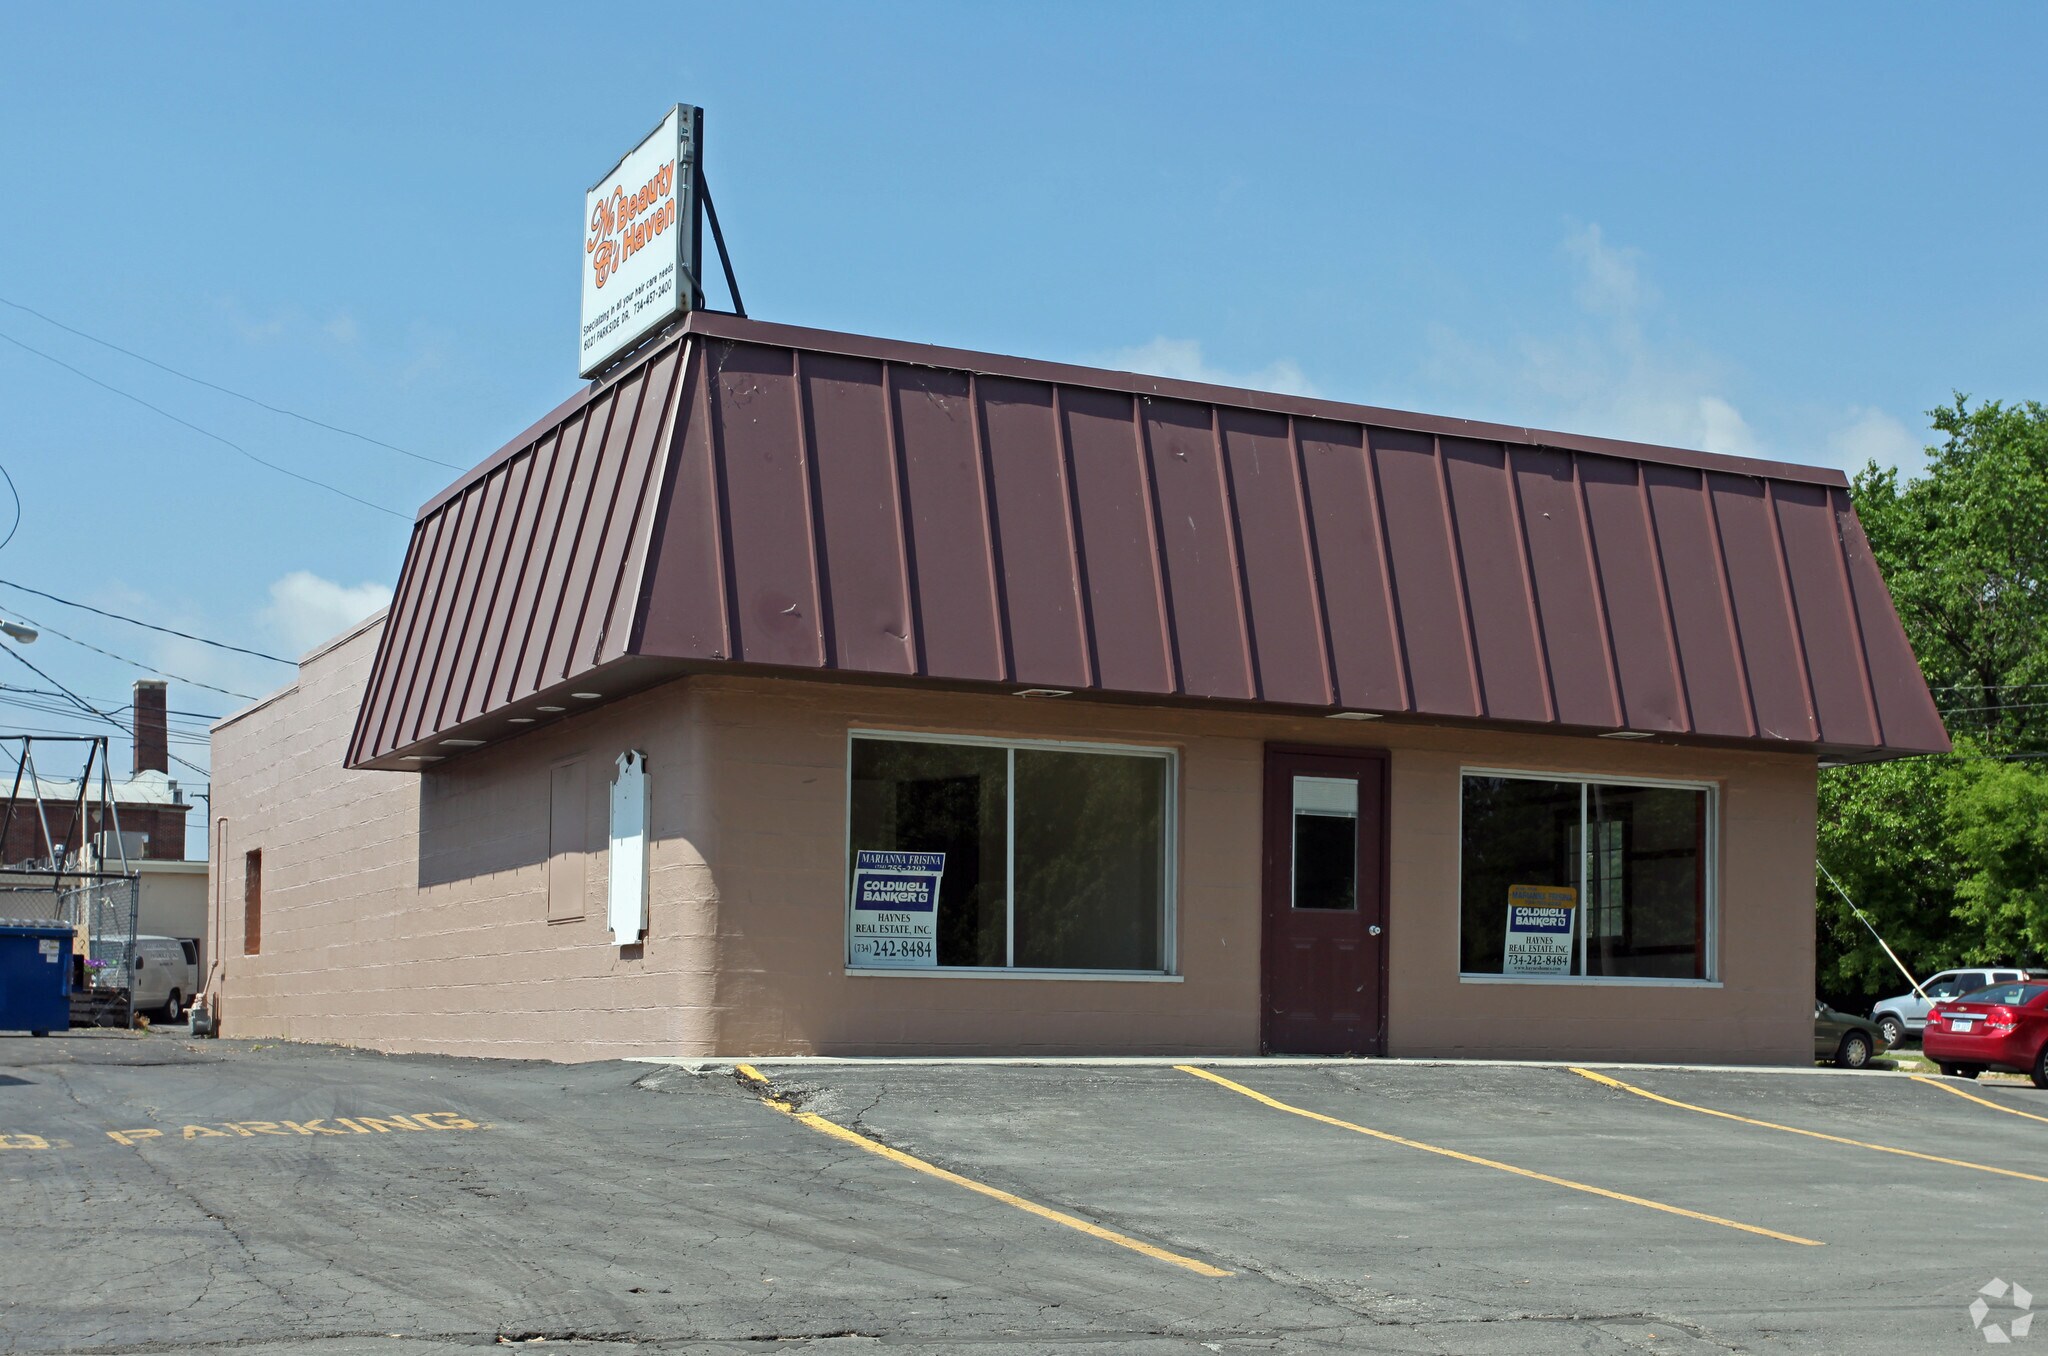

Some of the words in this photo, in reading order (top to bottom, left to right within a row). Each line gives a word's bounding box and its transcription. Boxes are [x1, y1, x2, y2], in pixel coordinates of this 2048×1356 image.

[616, 159, 674, 234] Beauty
[622, 197, 675, 263] Haven
[583, 310, 610, 337] Specializing
[622, 291, 635, 308] your
[634, 282, 645, 297] hair
[646, 275, 658, 289] care
[659, 263, 674, 280] needs
[583, 334, 596, 351] 6021
[596, 316, 620, 342] PARKSIDE
[621, 310, 631, 325] DR.
[861, 853, 907, 864] MARIANNA
[908, 855, 941, 865] FRISINA
[863, 891, 917, 904] BANKER
[878, 913, 911, 923] HAYNES
[1515, 916, 1557, 928] BANKER
[855, 924, 877, 934] REAL
[879, 924, 912, 935] ESTATE,
[914, 925, 932, 935] INC.
[1526, 936, 1554, 945] HAYNES
[854, 943, 872, 954] (734)
[873, 940, 932, 958] 242-8484
[1508, 944, 1526, 953] REAL
[1555, 945, 1569, 954] INC.
[1508, 954, 1568, 966] 734-242-8484
[106, 1112, 481, 1146] PARKING
